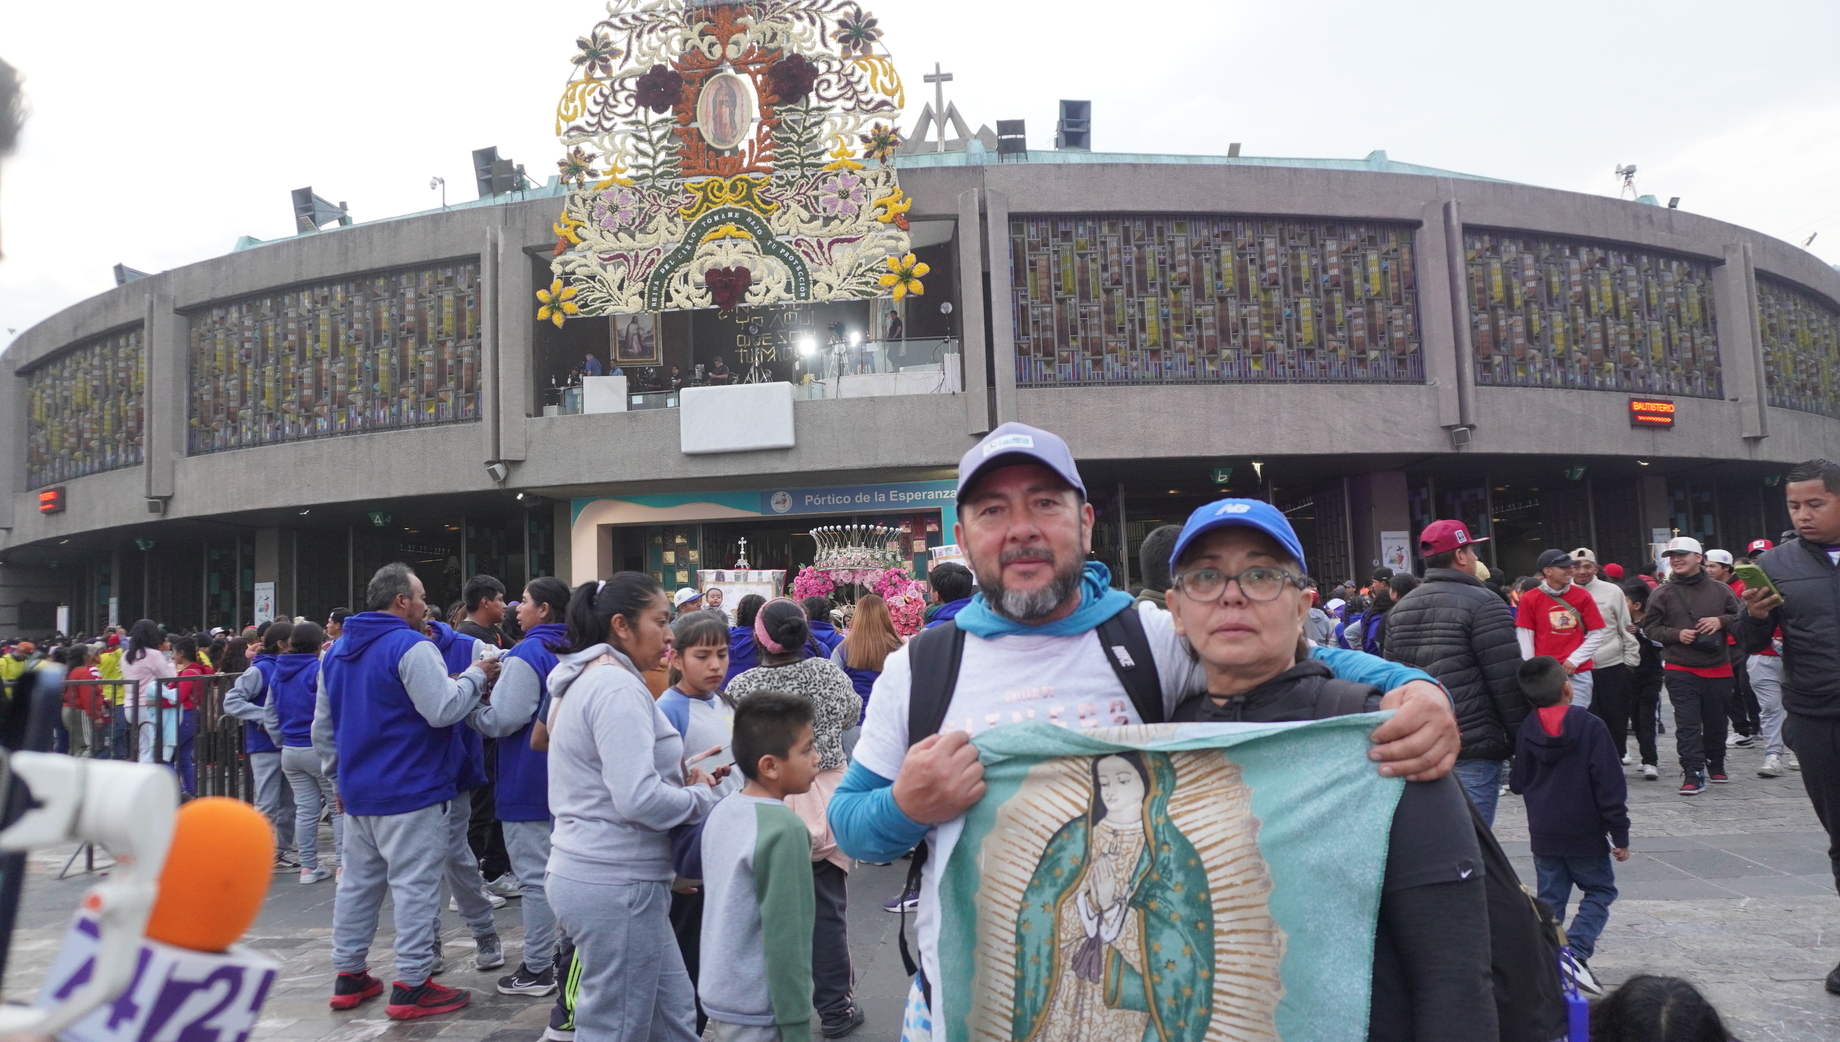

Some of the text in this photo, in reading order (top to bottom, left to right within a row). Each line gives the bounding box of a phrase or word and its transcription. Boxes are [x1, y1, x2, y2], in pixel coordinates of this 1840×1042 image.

[651, 280, 660, 307] REINA
[659, 259, 675, 274] DEL
[746, 216, 763, 235] BAJO
[767, 239, 778, 250] TU
[779, 248, 808, 297] PROTECCIÓN
[1631, 401, 1675, 413] BAUTISTERIO
[804, 488, 957, 506] Pórtico de la Esperanza
[1110, 645, 1136, 668] NIKE
